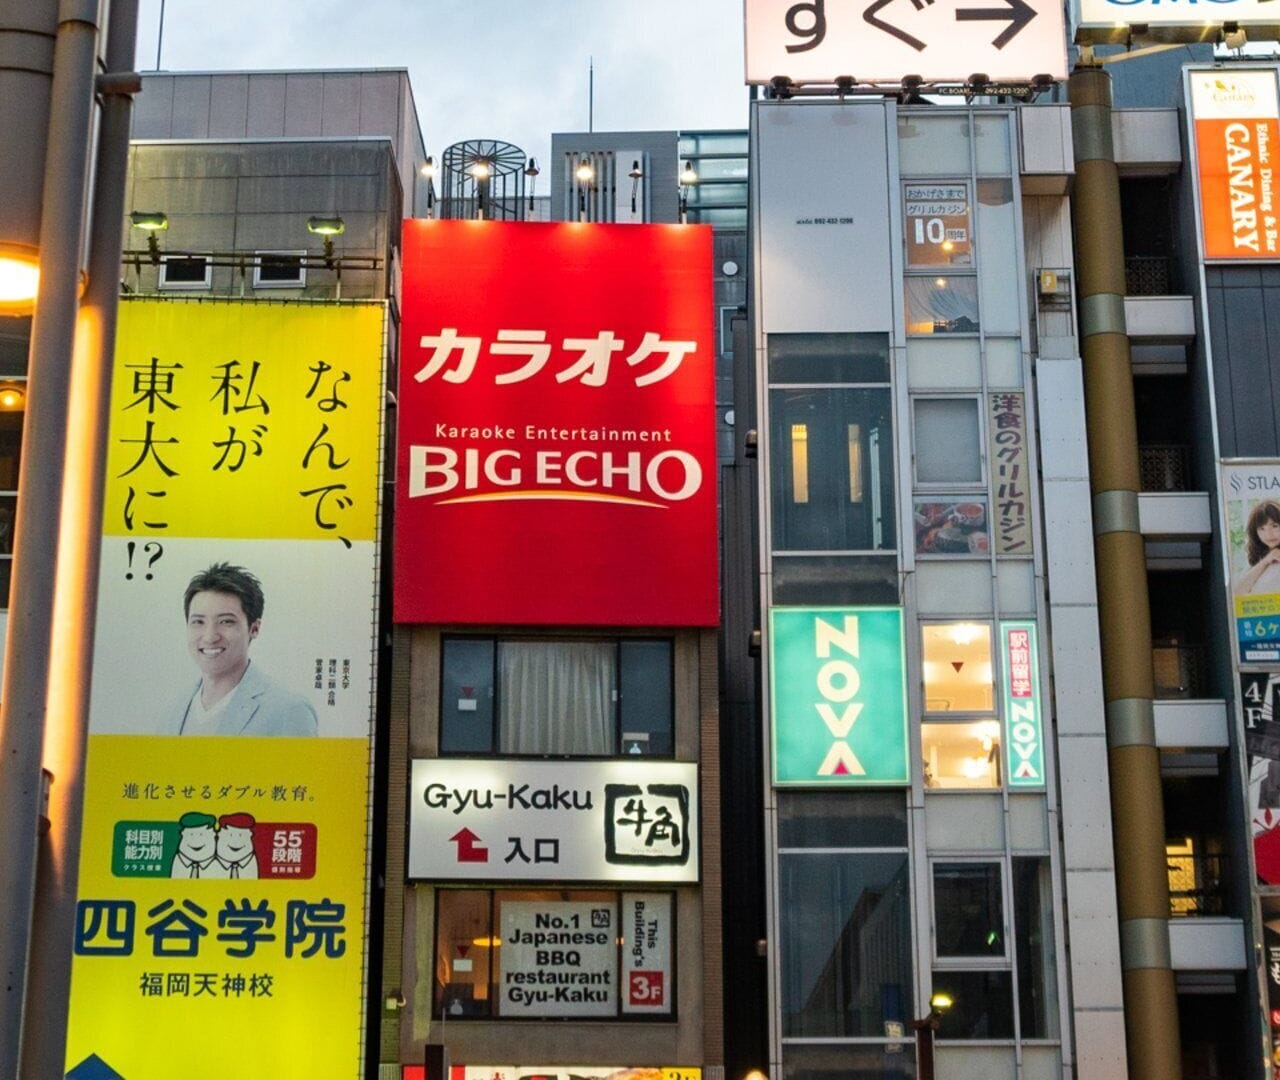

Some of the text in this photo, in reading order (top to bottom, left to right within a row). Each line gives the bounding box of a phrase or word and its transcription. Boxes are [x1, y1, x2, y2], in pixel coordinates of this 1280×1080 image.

[1224, 123, 1260, 252] CANARY
[1257, 122, 1279, 252] Ethnic Dining & Bar
[915, 218, 945, 245] 10
[414, 328, 697, 387] カラオケ
[209, 359, 270, 472] 私が
[435, 423, 672, 443] Karaoke Entertainment
[299, 360, 353, 549] なんで、
[409, 444, 703, 501] BIG ECHO
[992, 394, 1026, 552] 洋食のグリルカジン
[1009, 631, 1030, 697] 駅前留学
[814, 615, 866, 776] NOVA
[1010, 700, 1039, 778] NOVA
[122, 783, 317, 803] 進化させるダブル教育。
[423, 784, 593, 815] Gyu-Kaku
[125, 830, 163, 845] 科目別
[616, 799, 680, 848] 牛角
[124, 846, 163, 861] 能力別
[272, 848, 302, 863] 段階
[504, 837, 559, 864] 入口
[74, 898, 347, 959] 四谷学院
[535, 913, 580, 929] No.1
[632, 901, 645, 967] Building's
[648, 920, 658, 949] This
[509, 931, 608, 948] Japanese
[535, 950, 581, 967] BBQ
[139, 972, 274, 998] 福岡天神校
[506, 969, 610, 985] restaurant
[631, 976, 660, 1000] 3F
[507, 986, 608, 1004] Gyu-Kaku
